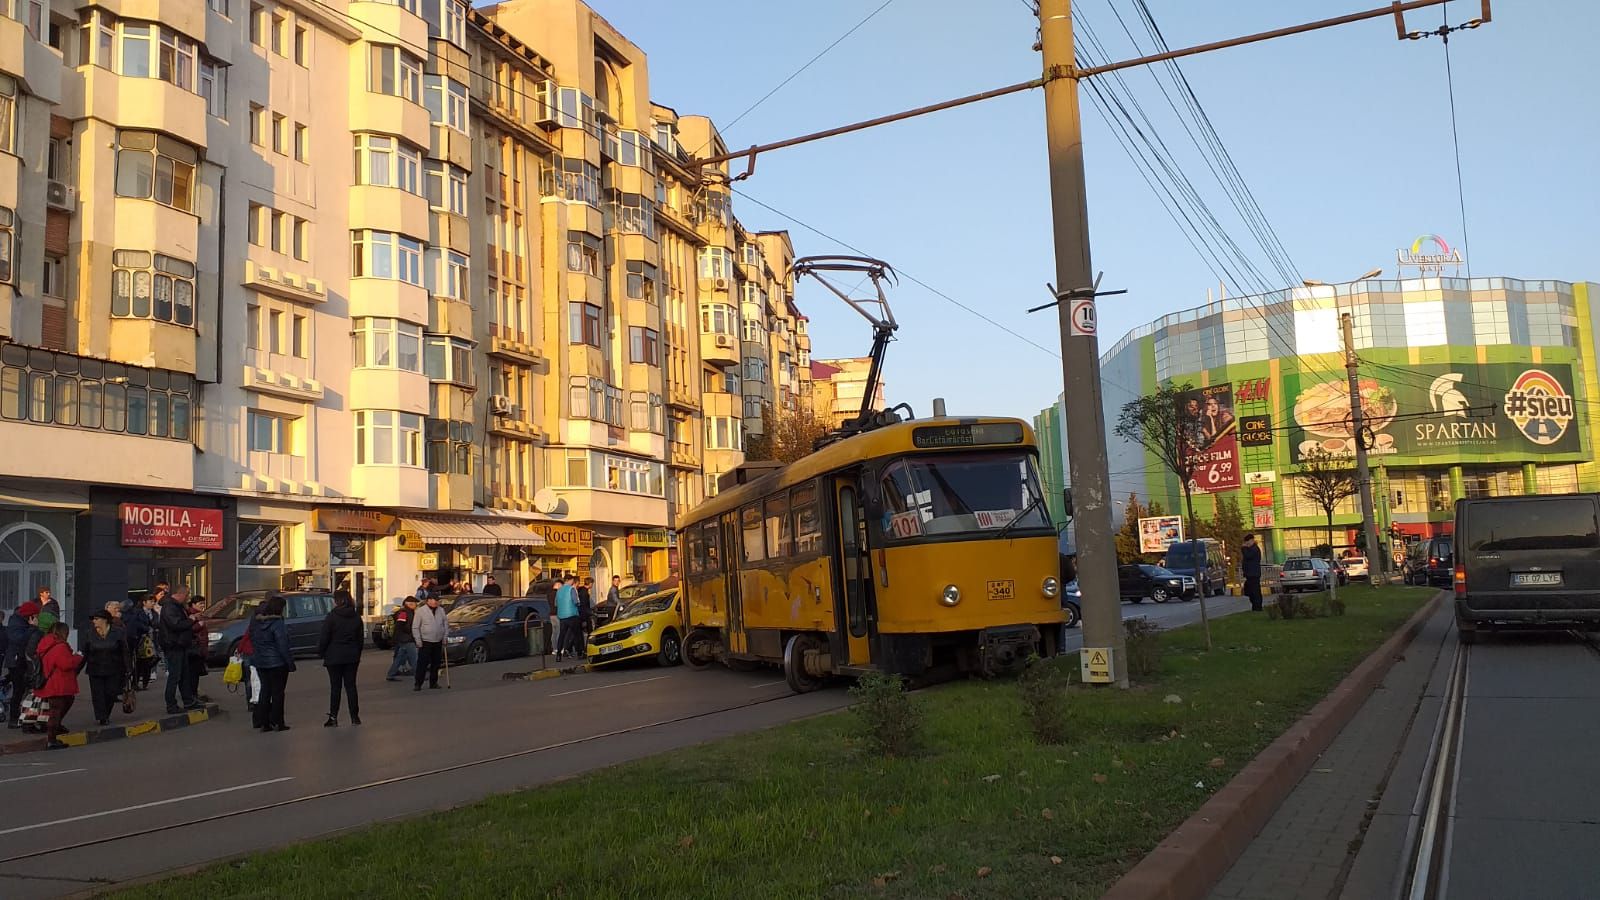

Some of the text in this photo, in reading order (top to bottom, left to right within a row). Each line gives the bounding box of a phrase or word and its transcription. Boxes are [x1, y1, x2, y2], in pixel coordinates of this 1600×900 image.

[1235, 377, 1270, 404] H&M
[1246, 420, 1265, 430] CINE
[1415, 422, 1496, 440] SPARTAN
[1242, 432, 1271, 441] GLOBE
[1210, 450, 1232, 461] FILM
[125, 506, 191, 528] MOBILA
[978, 512, 993, 527] 101
[132, 528, 143, 536] LA
[893, 516, 920, 537] 101
[543, 525, 577, 543] Rocri
[1532, 574, 1541, 582] 07
[1543, 573, 1560, 583] LYE
[993, 587, 1010, 595] 340
